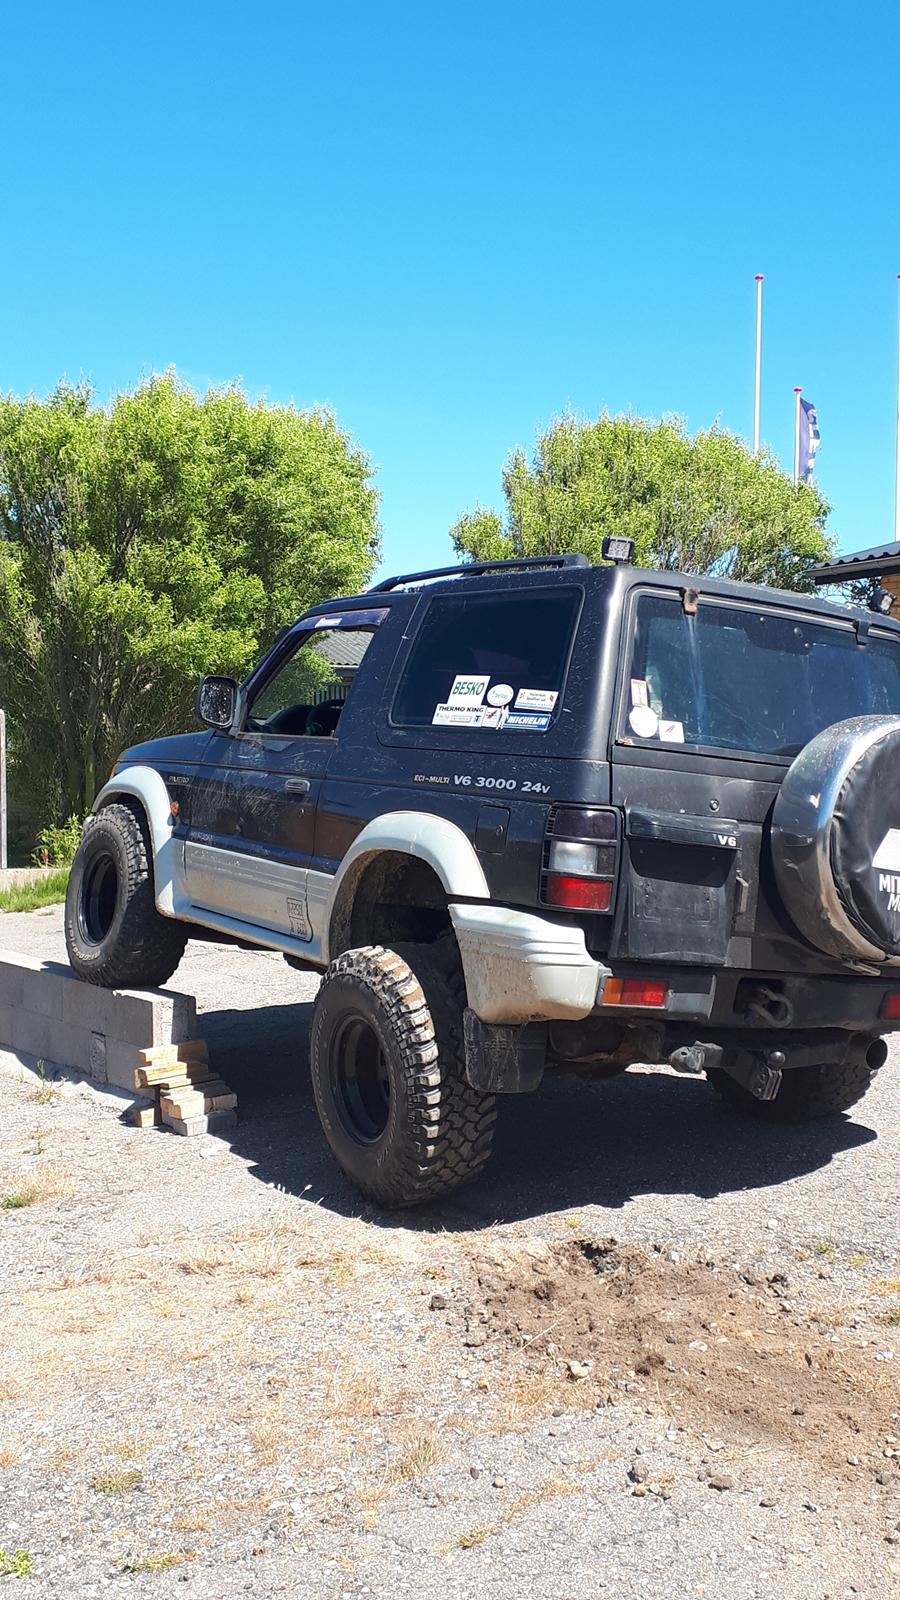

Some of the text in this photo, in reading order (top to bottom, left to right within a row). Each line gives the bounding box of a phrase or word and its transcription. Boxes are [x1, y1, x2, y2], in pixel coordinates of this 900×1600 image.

[452, 681, 485, 696] BESKO
[506, 714, 549, 726] MICHELIN
[453, 775, 472, 786] V6
[475, 777, 517, 790] 3000
[717, 834, 737, 847] V6
